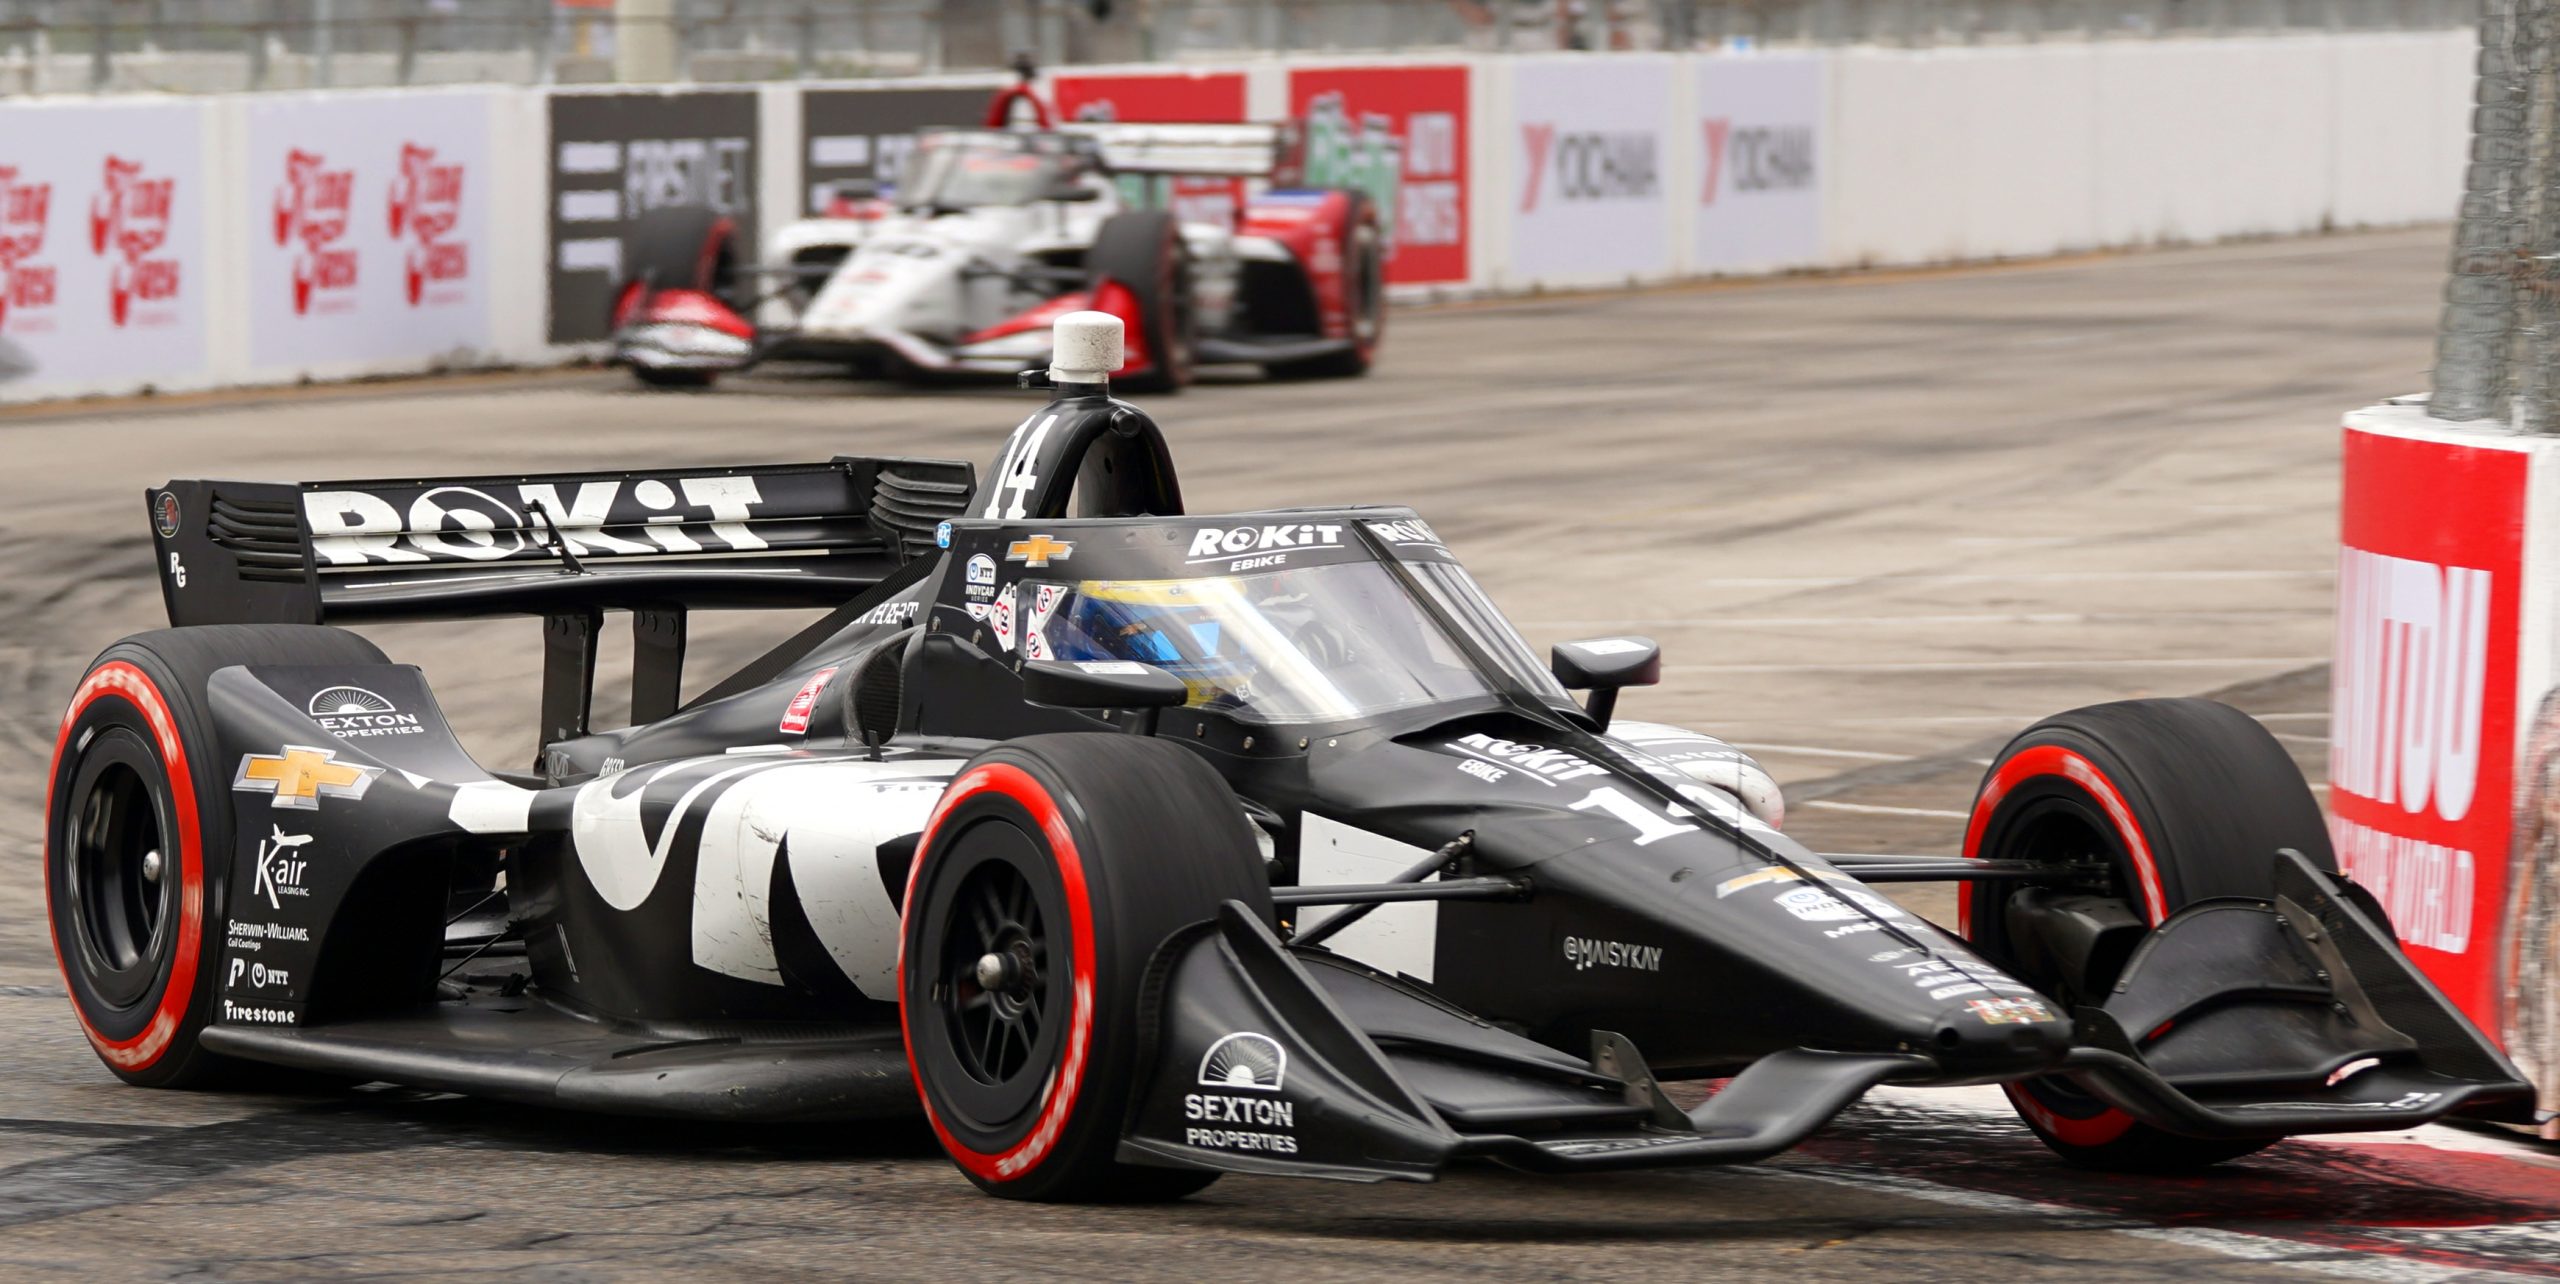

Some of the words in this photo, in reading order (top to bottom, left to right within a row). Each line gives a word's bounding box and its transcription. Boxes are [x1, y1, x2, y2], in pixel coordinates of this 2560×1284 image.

[984, 414, 1058, 519] 14
[1230, 554, 1286, 572] EBIKE
[979, 567, 994, 578] NTT
[965, 584, 995, 597] INDYCAR
[313, 713, 418, 729] EXTON
[332, 725, 424, 738] OPERTIES
[1458, 759, 1509, 783] EBIKE
[267, 969, 289, 985] NTT
[224, 999, 295, 1023] Firestone
[1185, 1093, 1294, 1127] SEXTON
[1186, 1127, 1298, 1153] PROPERTIES
